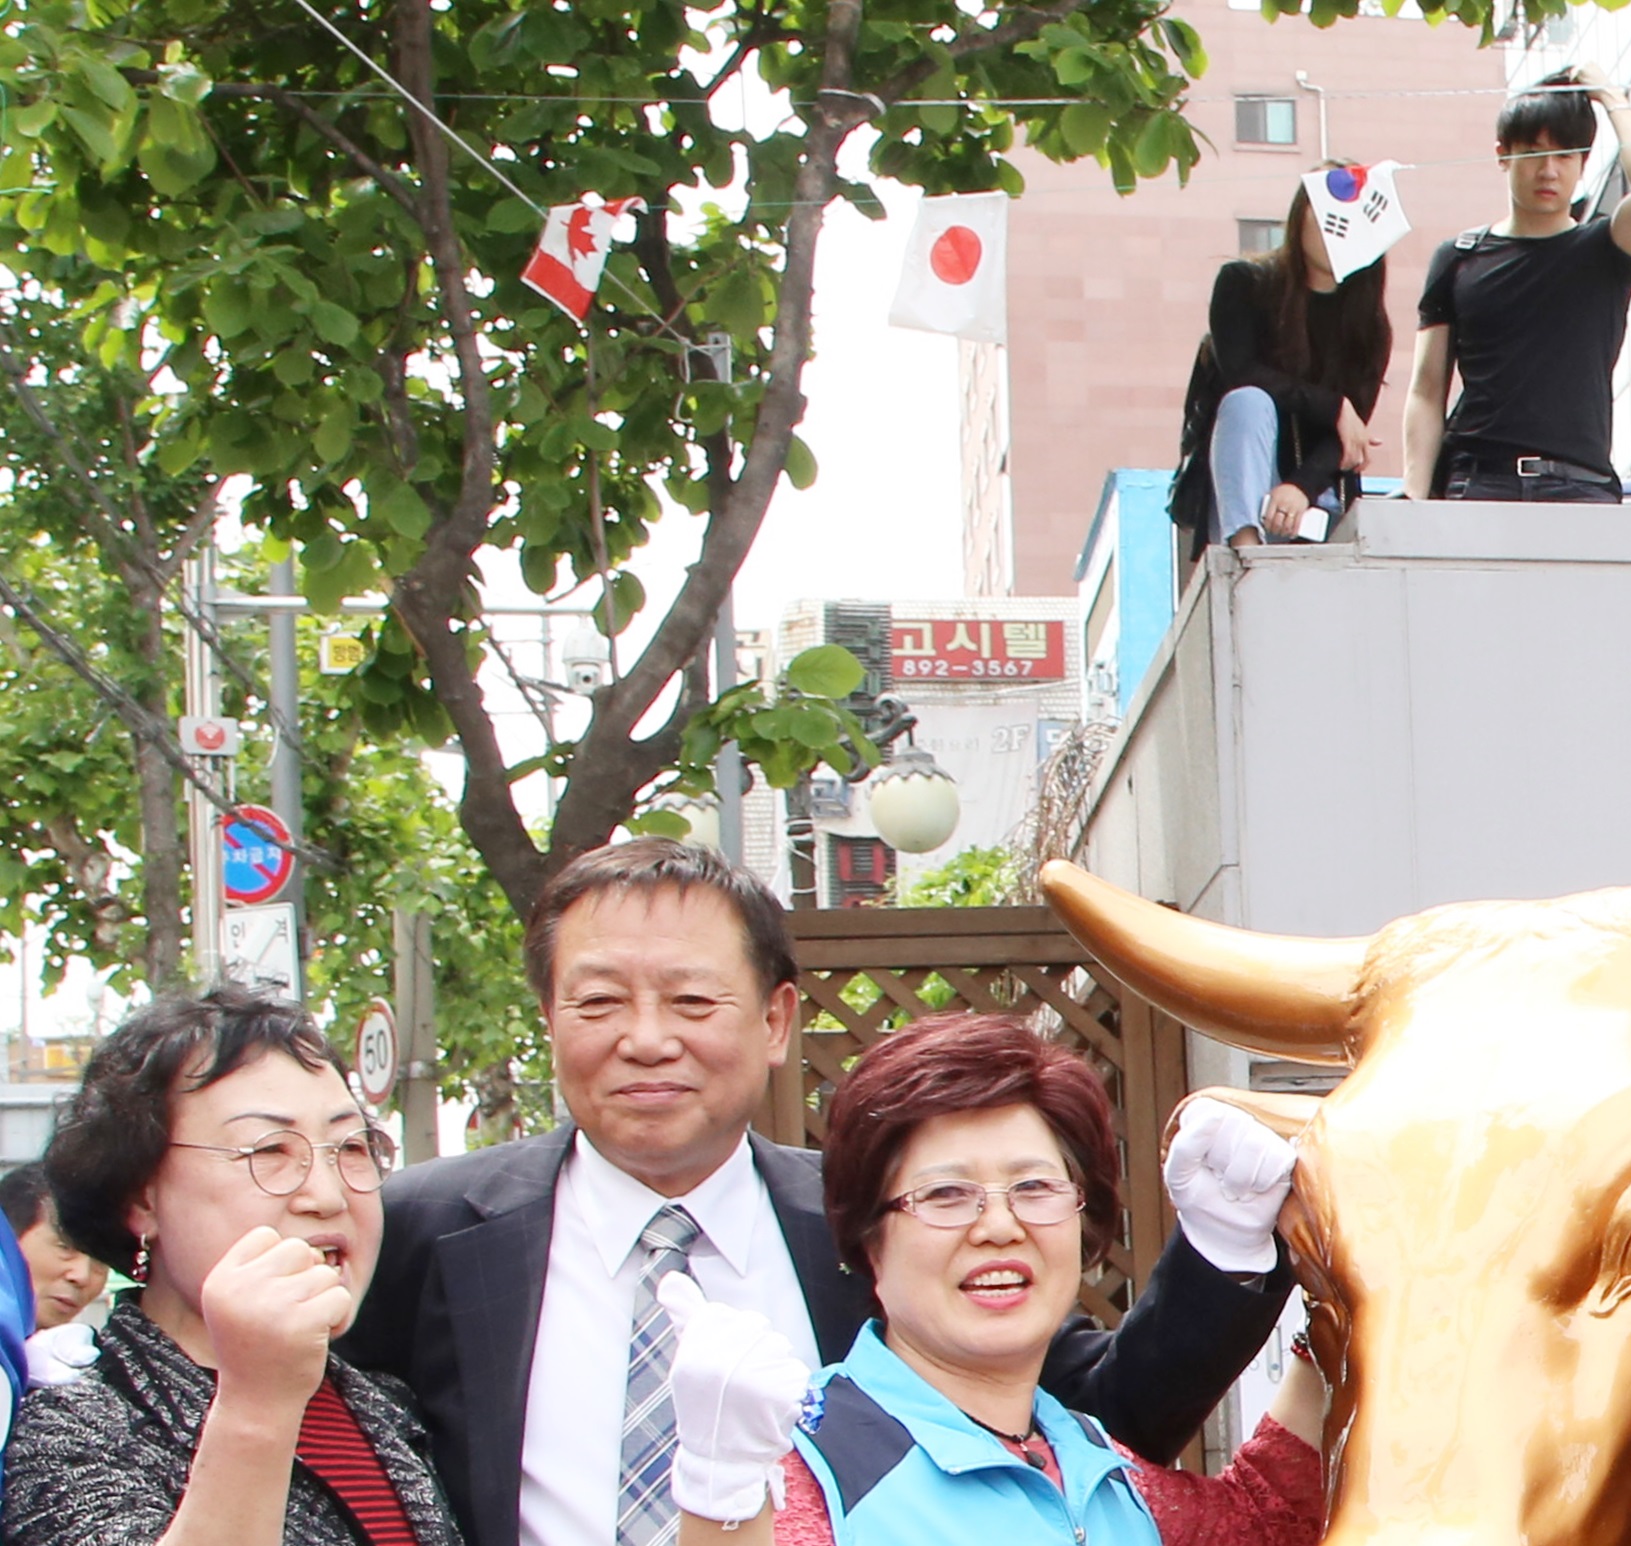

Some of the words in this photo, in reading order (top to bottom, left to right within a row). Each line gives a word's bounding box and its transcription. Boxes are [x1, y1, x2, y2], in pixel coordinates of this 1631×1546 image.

[893, 622, 1047, 659] 고시텔
[902, 659, 1034, 676] 892-3567
[990, 722, 1030, 754] 2F
[365, 1029, 388, 1075] 50
